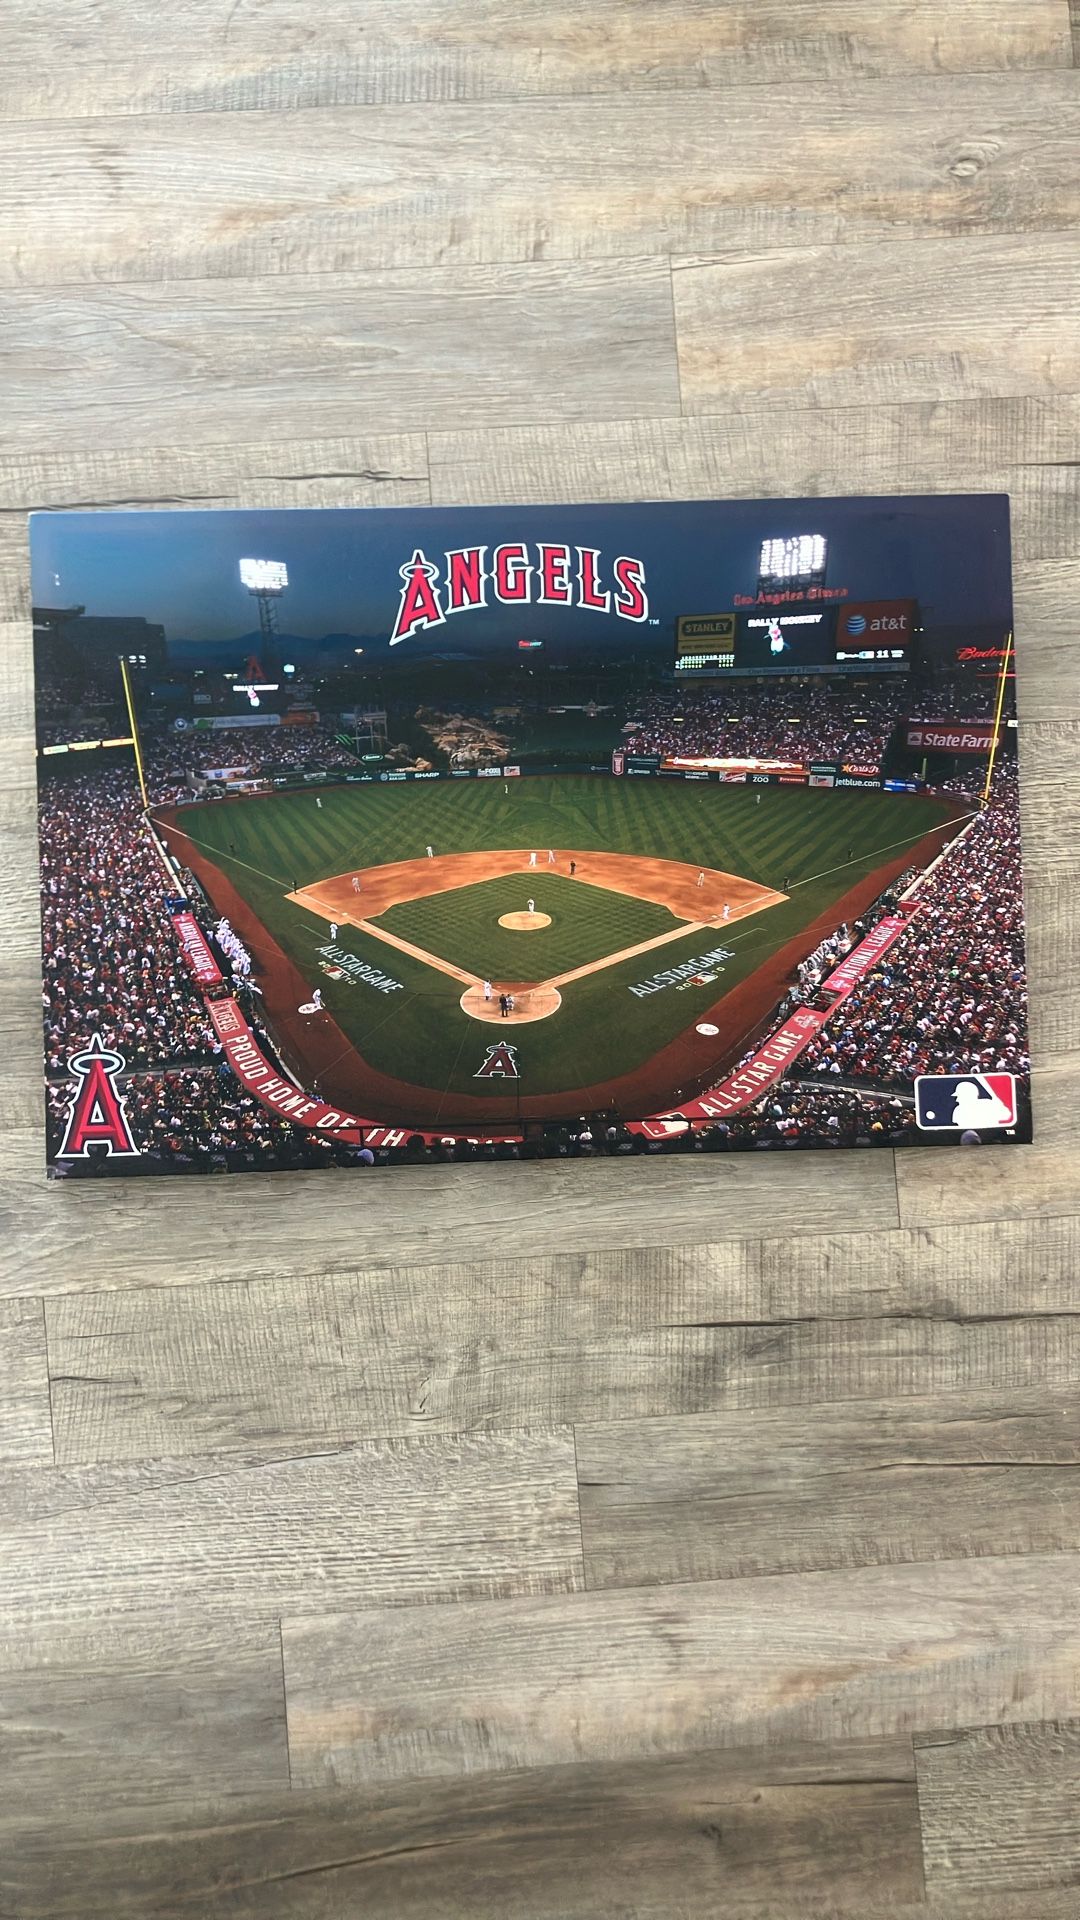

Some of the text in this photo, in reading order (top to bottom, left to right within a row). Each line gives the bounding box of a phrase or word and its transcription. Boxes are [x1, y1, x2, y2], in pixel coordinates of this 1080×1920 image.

[389, 543, 649, 646] ANGELS
[685, 622, 730, 633] STANLEY
[870, 615, 907, 630] at&t
[924, 733, 1000, 748] State Farm
[835, 778, 880, 788] jetblue.com
[836, 925, 896, 980] NATIONAL LEAGUE
[209, 1000, 241, 1034] ANGELS
[472, 1041, 519, 1078] A
[762, 1029, 804, 1061] GAME
[54, 1033, 142, 1158] A
[226, 1034, 405, 1147] PROUD HOME OF TH
